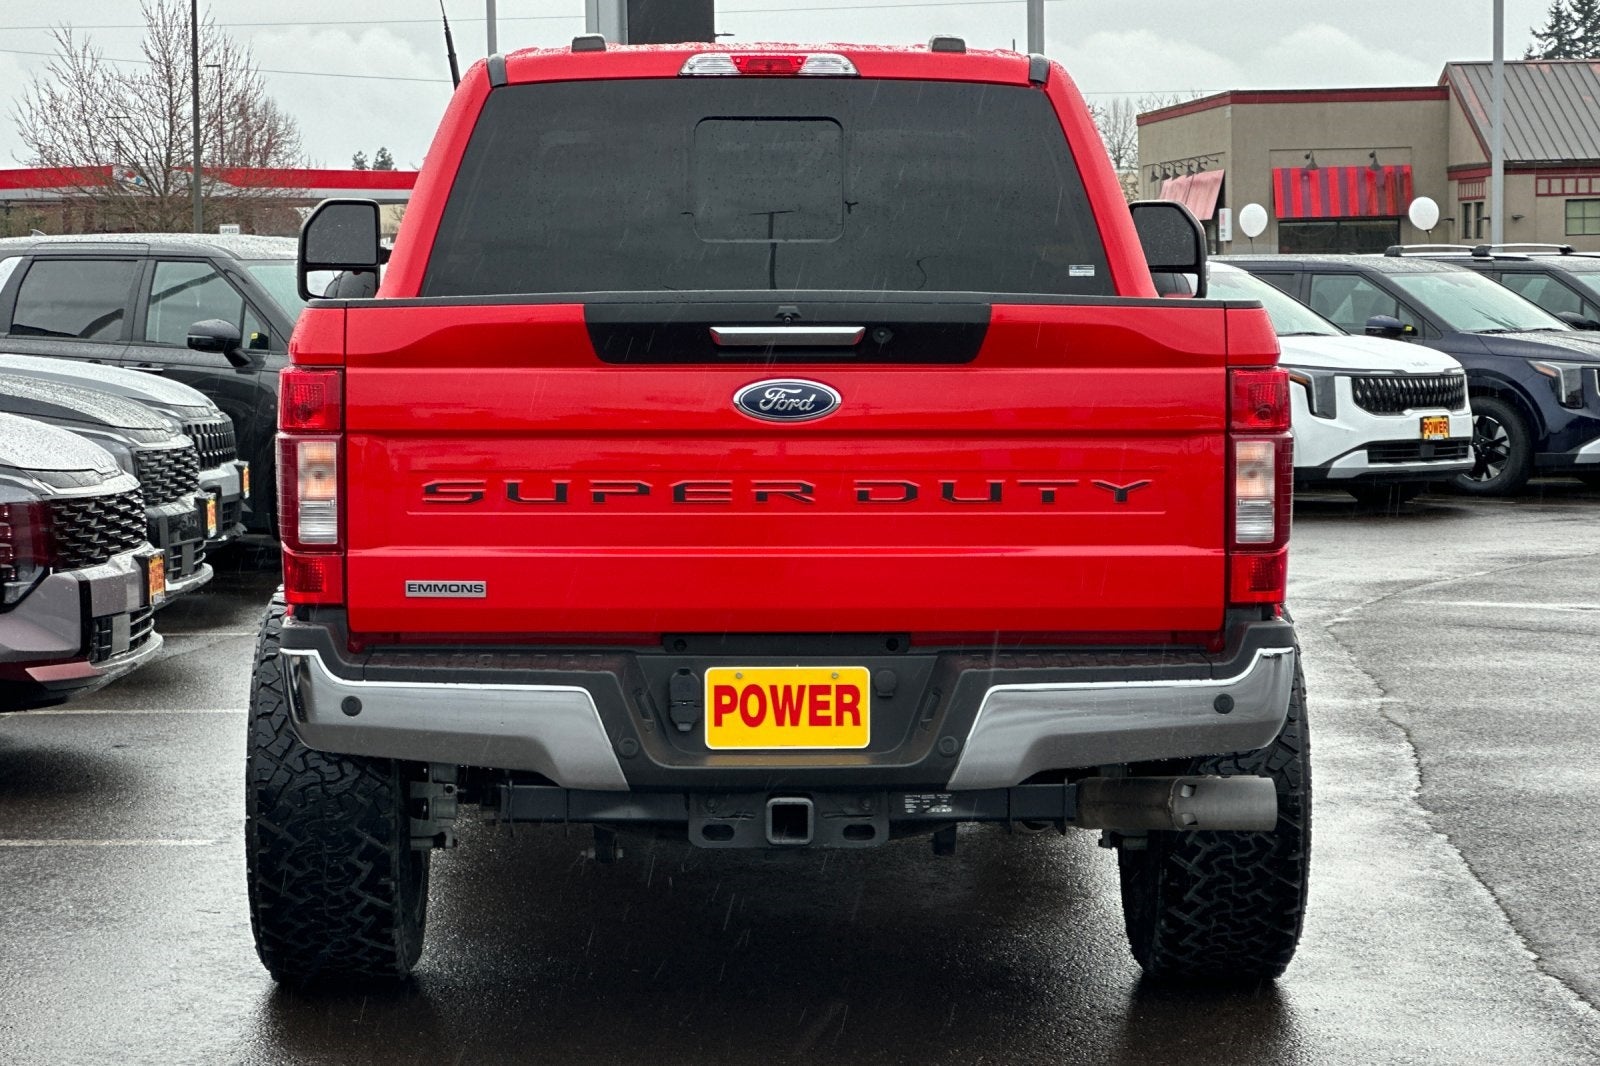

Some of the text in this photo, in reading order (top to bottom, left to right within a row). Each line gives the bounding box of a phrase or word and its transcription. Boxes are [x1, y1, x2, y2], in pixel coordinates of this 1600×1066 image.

[760, 387, 816, 411] Ford
[1423, 420, 1448, 434] POWER
[421, 479, 1153, 504] SUPER DUTY
[407, 583, 485, 593] EMMONS
[713, 684, 861, 728] POWER
